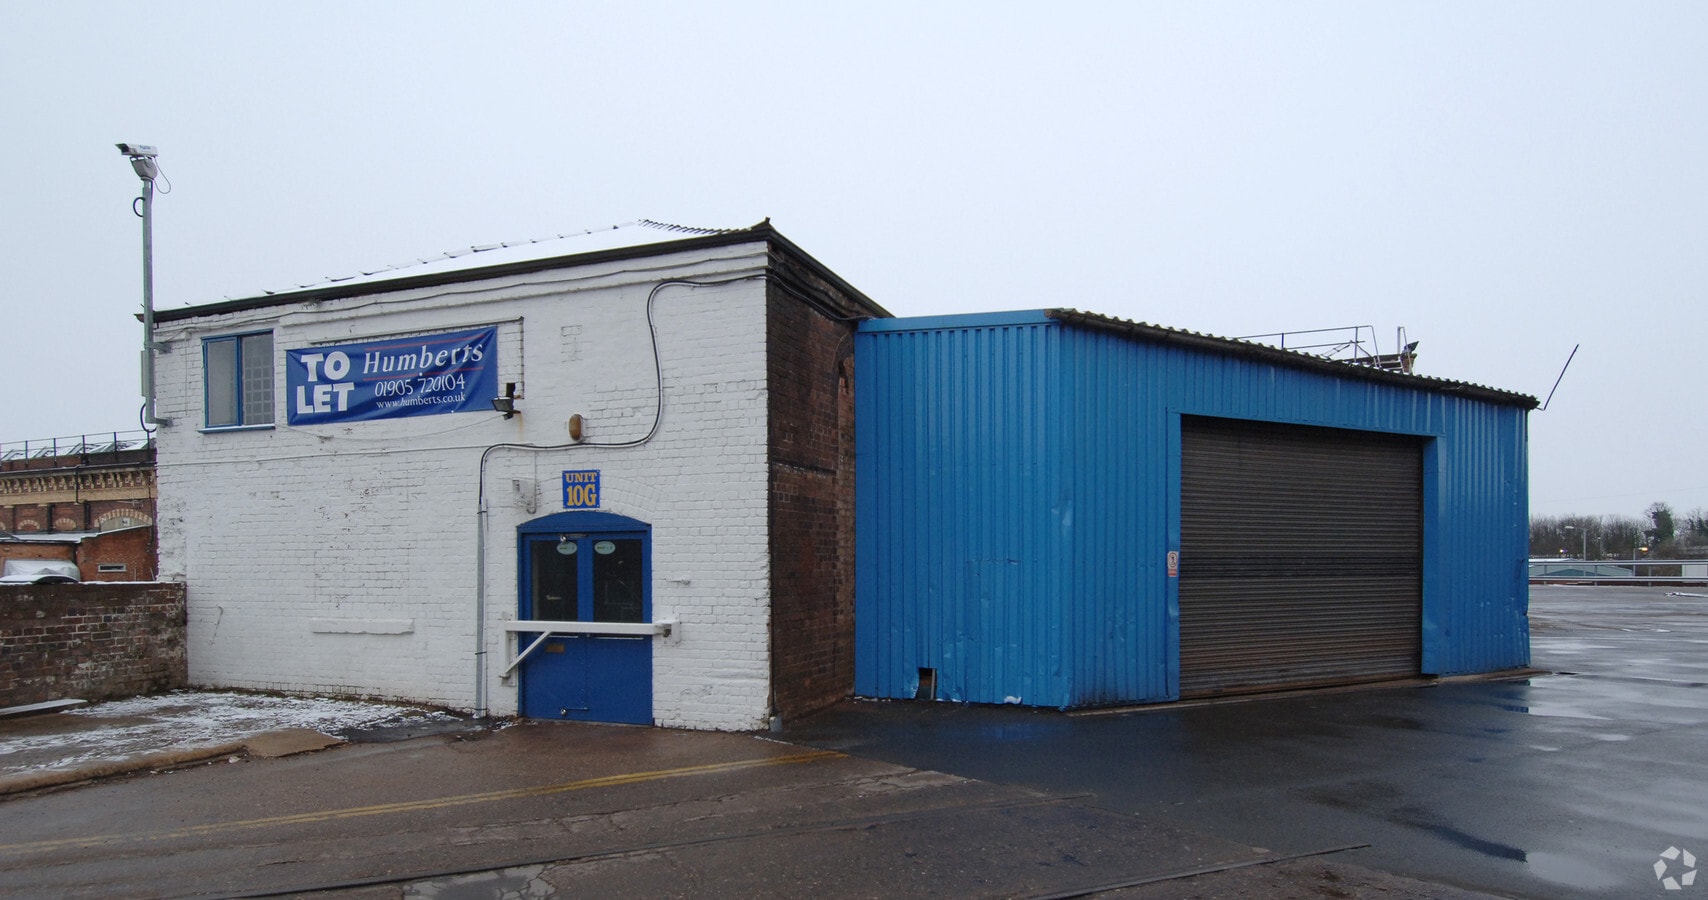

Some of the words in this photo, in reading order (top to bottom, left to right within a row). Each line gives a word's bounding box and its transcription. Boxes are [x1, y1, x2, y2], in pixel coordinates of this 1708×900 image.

[301, 351, 351, 382] TO
[362, 343, 484, 374] Humberts
[374, 379, 414, 397] 01905
[417, 373, 466, 394] 720104
[296, 382, 355, 414] LET
[376, 391, 466, 409] www.humberts.co.uk
[565, 472, 598, 483] UNIT
[566, 483, 597, 506] 10G
